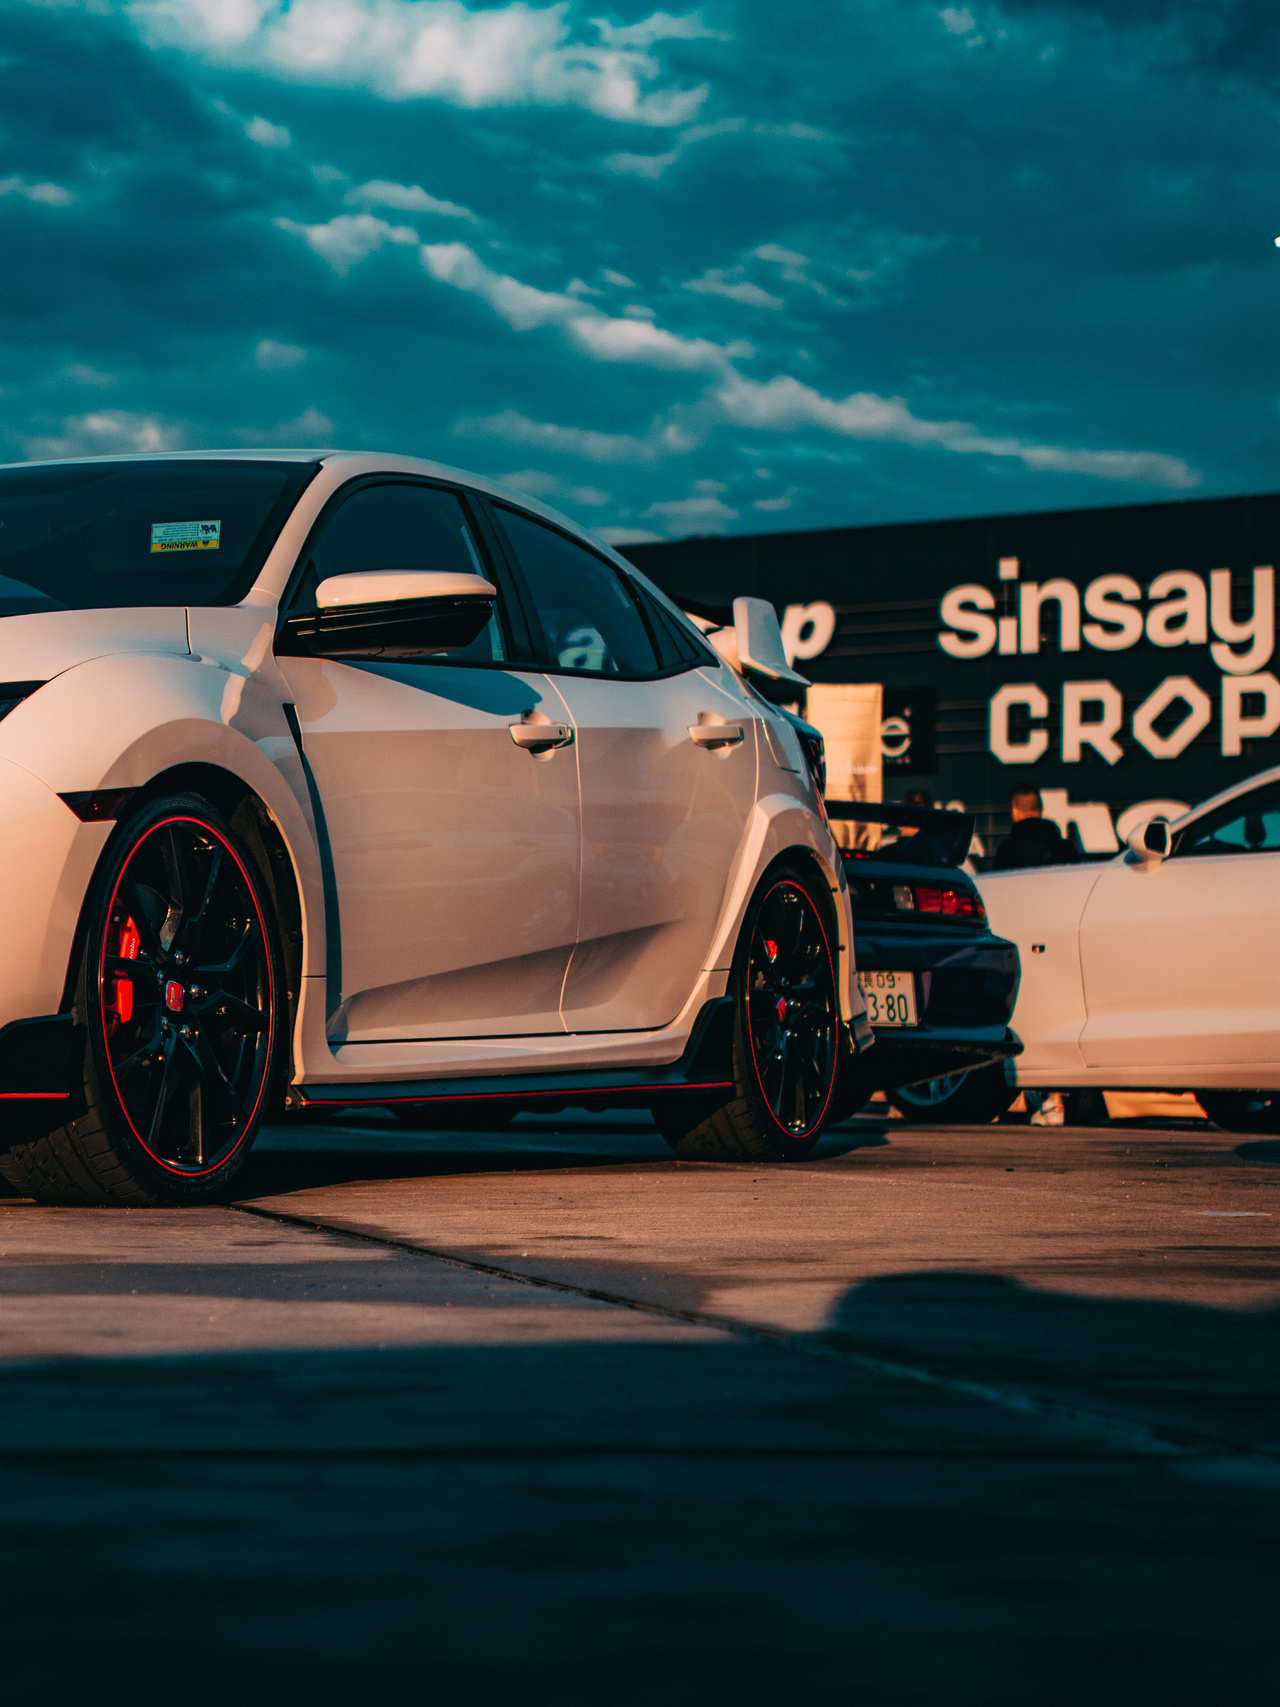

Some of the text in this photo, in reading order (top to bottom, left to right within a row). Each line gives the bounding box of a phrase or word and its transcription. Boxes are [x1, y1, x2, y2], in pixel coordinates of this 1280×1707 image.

[161, 541, 198, 550] WARNING
[938, 556, 1275, 676] sinsay
[990, 671, 1280, 766] CROP
